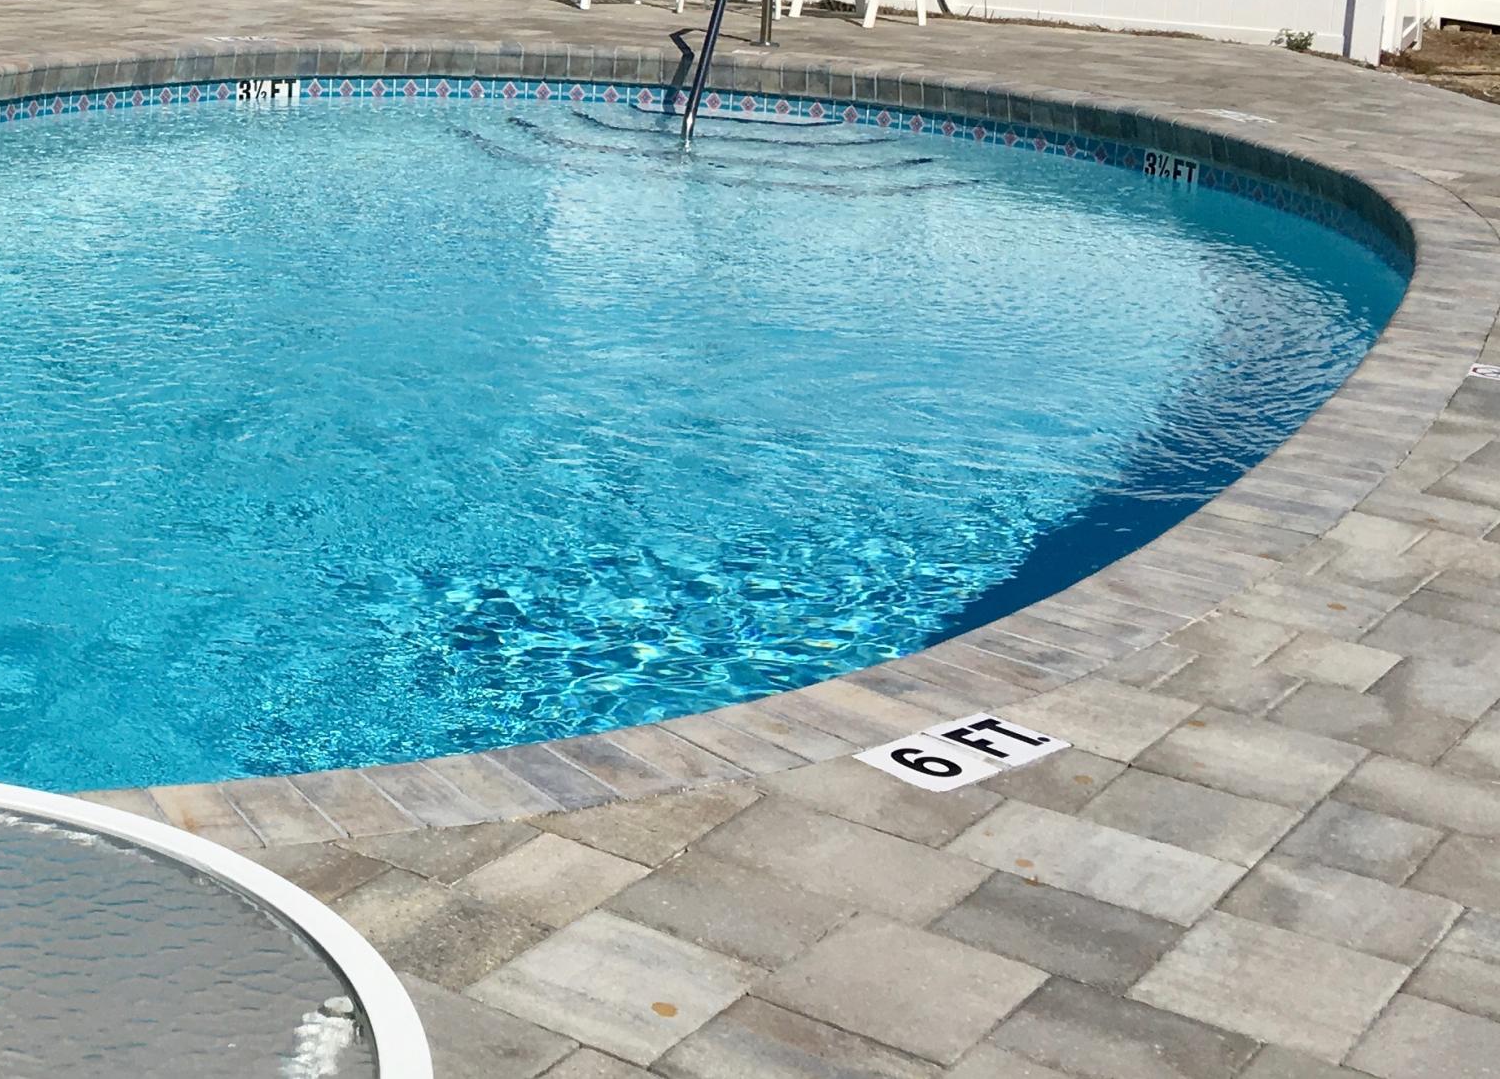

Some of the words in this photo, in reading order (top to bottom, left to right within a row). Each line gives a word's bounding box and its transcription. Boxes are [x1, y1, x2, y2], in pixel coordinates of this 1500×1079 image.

[271, 78, 297, 98] FT
[1172, 158, 1197, 183] FT
[891, 748, 963, 777] 6
[941, 718, 1051, 759] FT.
